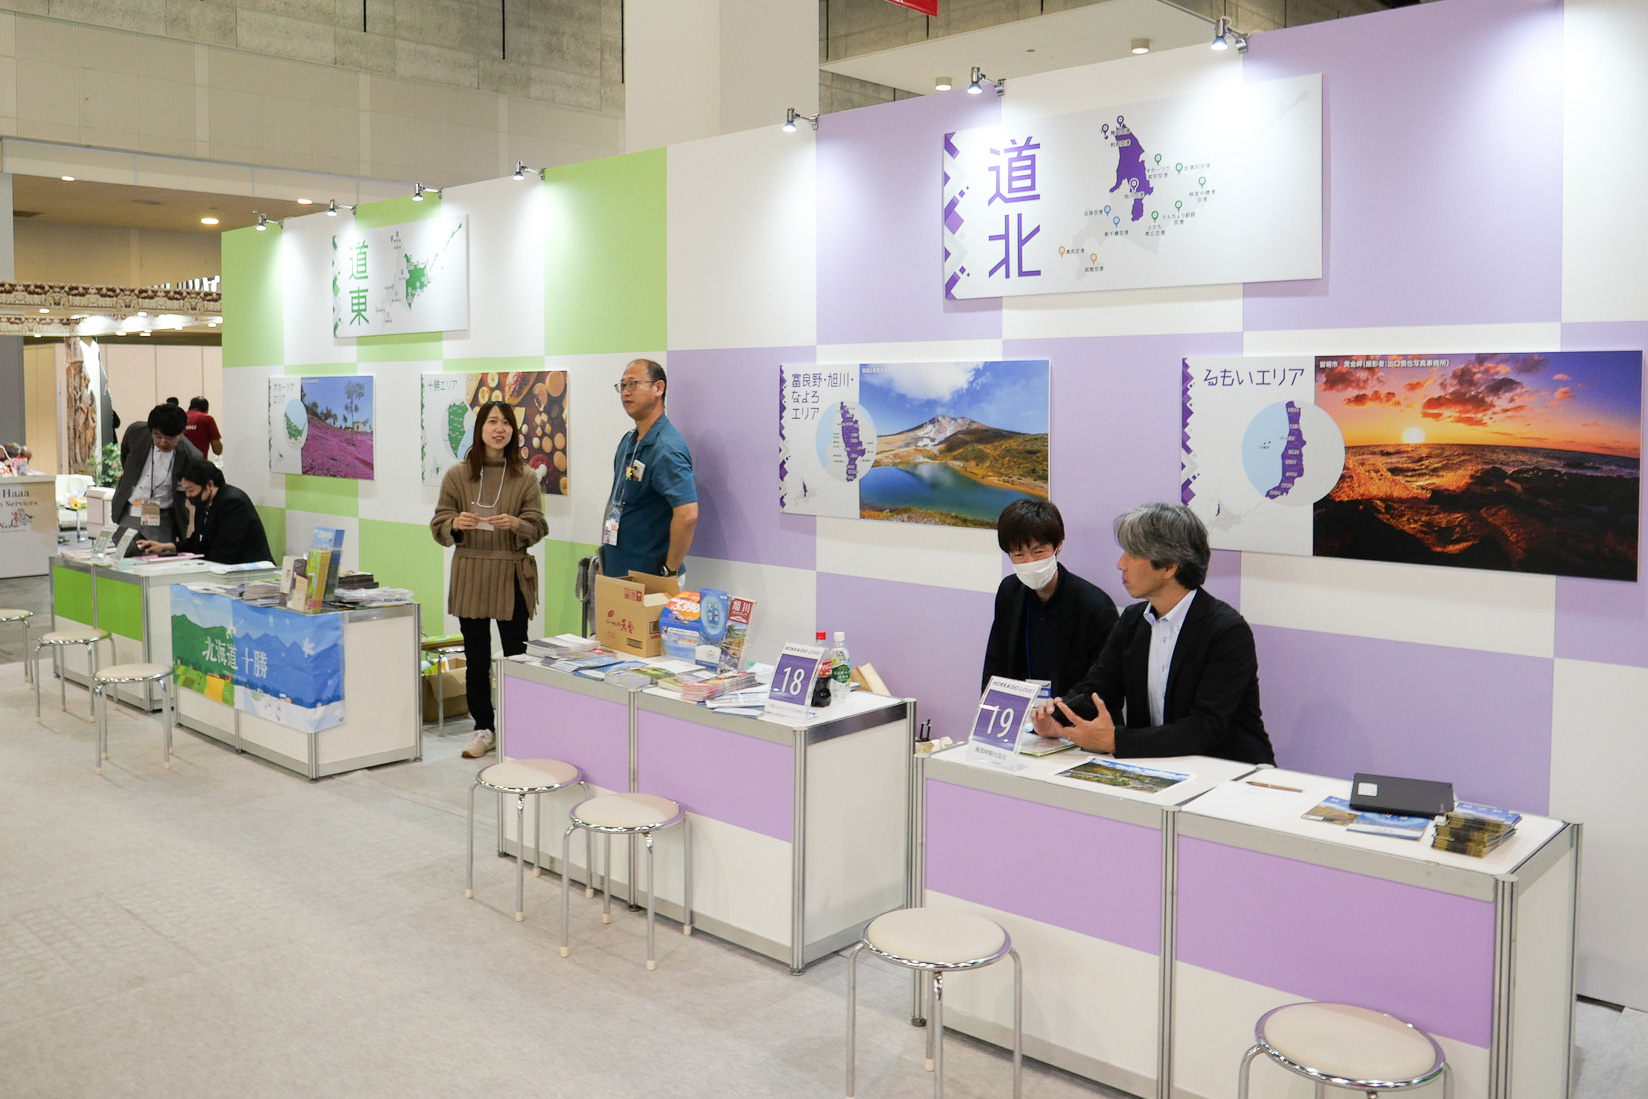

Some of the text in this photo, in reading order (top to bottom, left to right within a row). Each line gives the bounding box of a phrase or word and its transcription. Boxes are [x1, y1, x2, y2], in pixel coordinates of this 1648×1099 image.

[988, 136, 1042, 279] 道北
[349, 240, 369, 326] 道東
[1203, 368, 1305, 387] るもいエリア
[791, 390, 820, 404] なよろ
[791, 407, 820, 420] エリア
[731, 600, 751, 614] 旭川
[780, 666, 805, 696] 18
[993, 680, 1019, 691] HOKKAIDO
[985, 705, 1015, 738] 19
